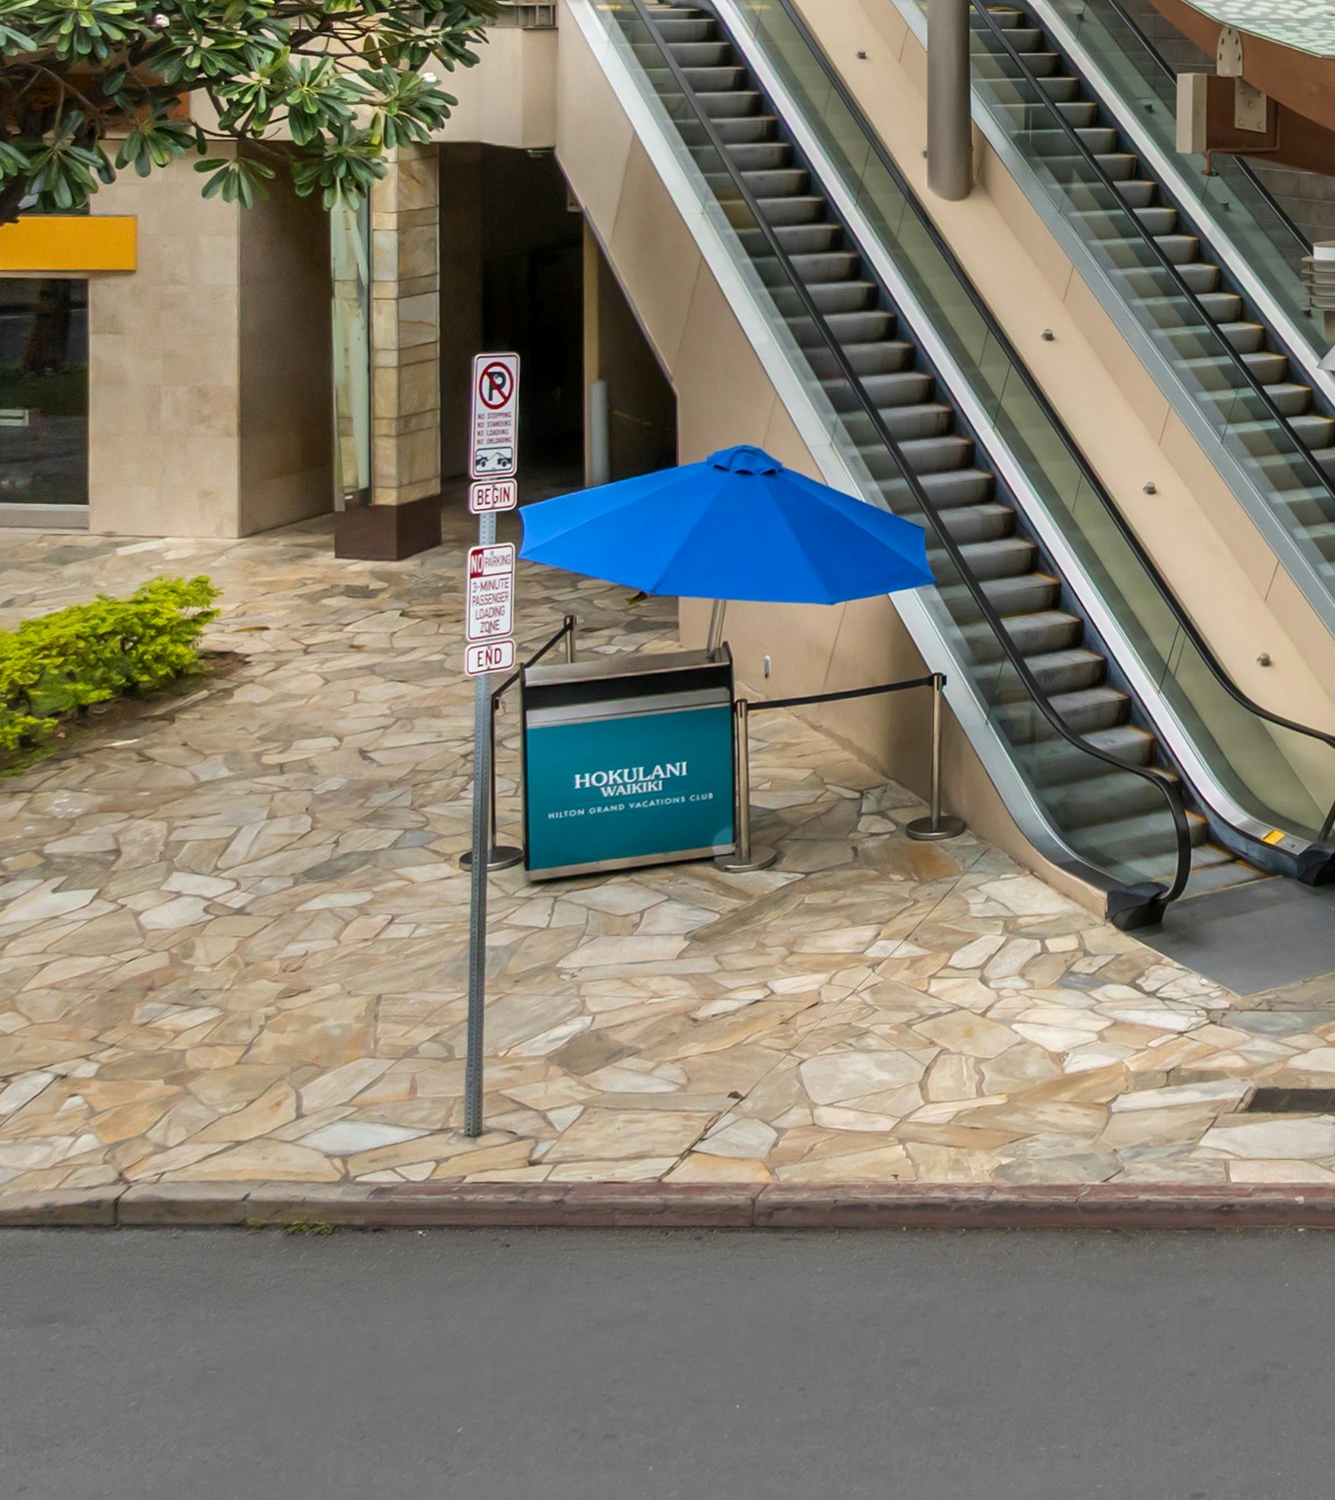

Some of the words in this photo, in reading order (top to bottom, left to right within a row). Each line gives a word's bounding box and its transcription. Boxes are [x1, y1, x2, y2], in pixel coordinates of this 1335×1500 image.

[486, 420, 512, 428] STANDING
[486, 428, 509, 437] LOADING
[477, 486, 511, 506] BEGIN
[471, 553, 484, 575] NO
[485, 554, 511, 567] PARKING
[472, 577, 510, 593] 3-MINUTE
[472, 591, 509, 607] PASSENGER
[475, 605, 506, 620] LOADING
[479, 619, 500, 633] ZONE
[477, 647, 502, 668] END
[574, 761, 688, 789] HOKULANI
[600, 780, 663, 798] WAIKIKI
[547, 808, 585, 819] HILTON
[588, 803, 625, 815] GRAND
[629, 796, 686, 809] VACATIONS
[689, 792, 714, 802] CLUB
